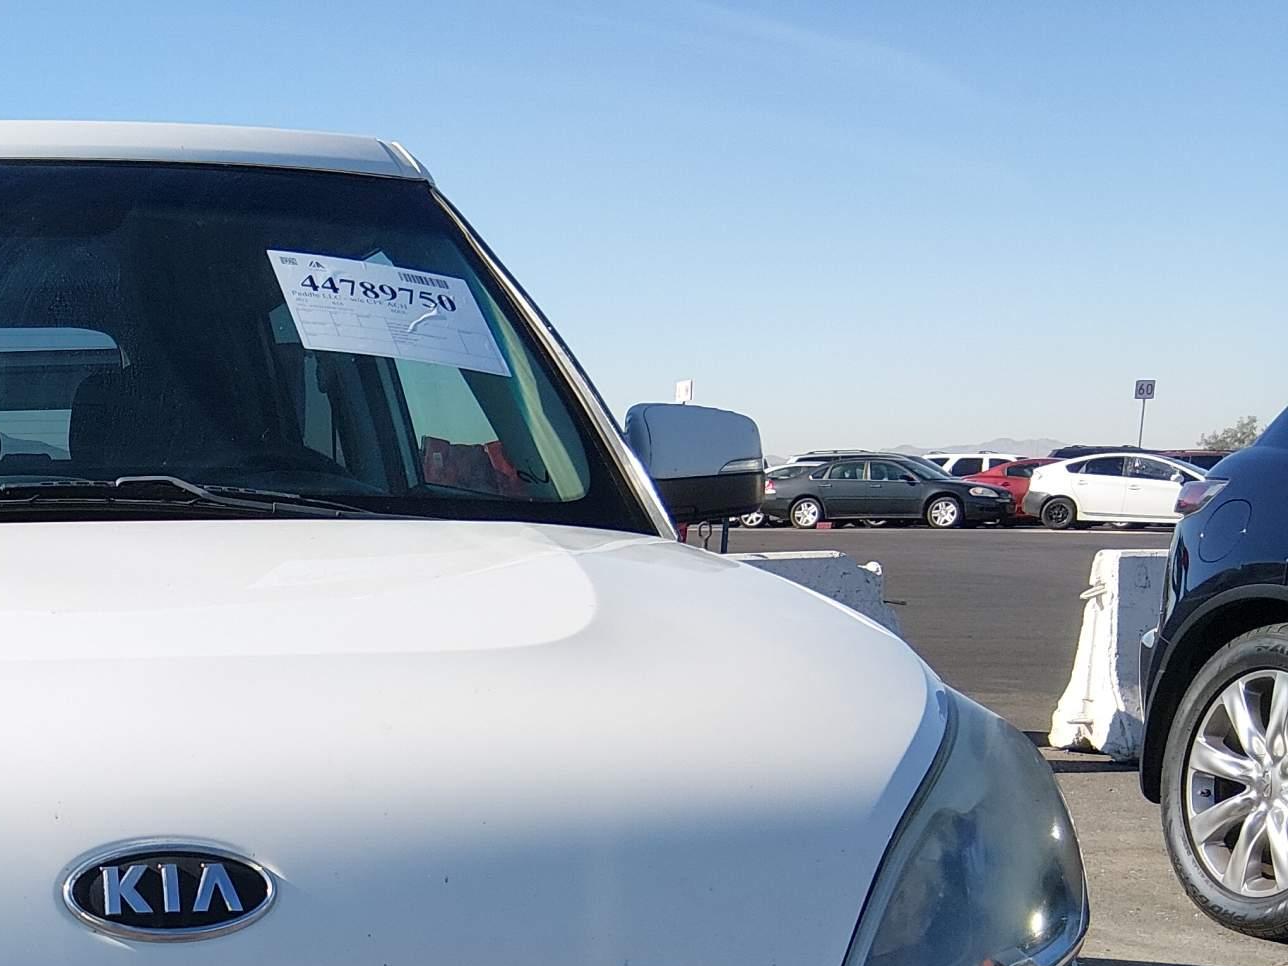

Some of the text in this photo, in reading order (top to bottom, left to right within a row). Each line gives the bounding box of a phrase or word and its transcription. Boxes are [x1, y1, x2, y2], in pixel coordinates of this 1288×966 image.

[301, 274, 457, 312] 44789750
[1138, 383, 1153, 396] 60
[100, 863, 244, 916] KIA
